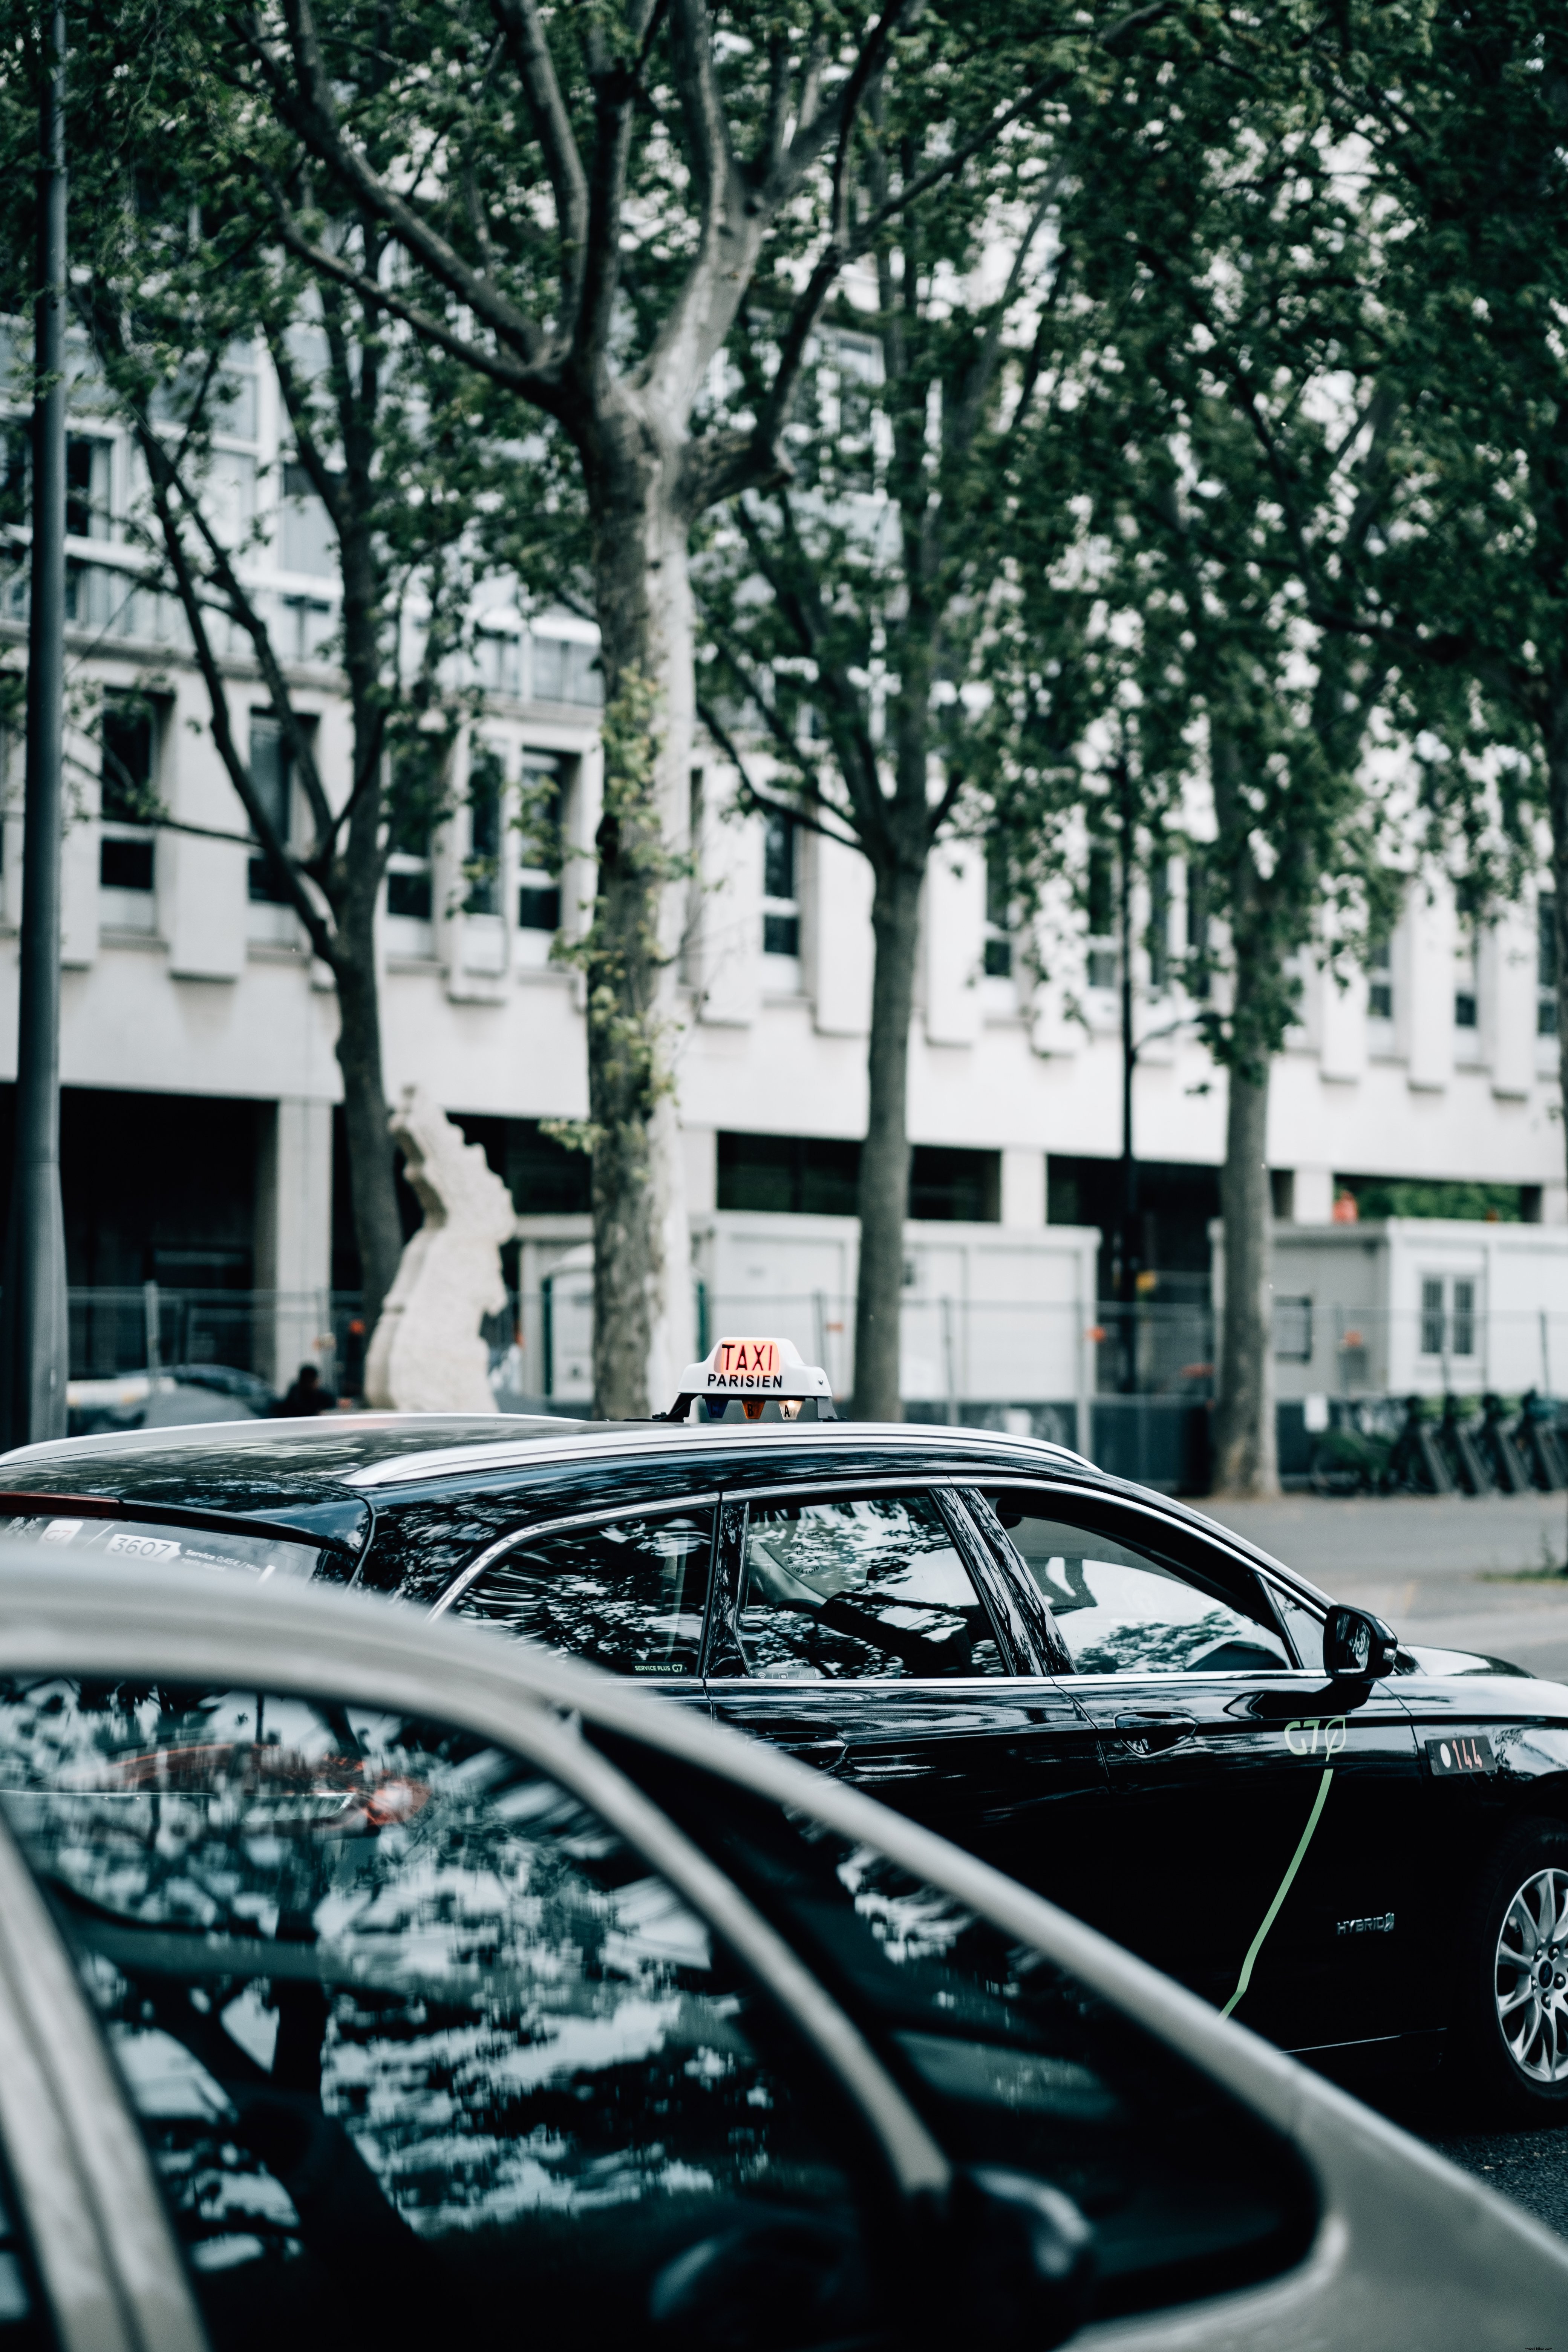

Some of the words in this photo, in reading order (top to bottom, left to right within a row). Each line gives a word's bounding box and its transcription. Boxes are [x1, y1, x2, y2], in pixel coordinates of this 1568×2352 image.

[722, 1344, 773, 1371] TAXI
[707, 1374, 782, 1388] PARISIEN
[747, 1403, 753, 1417] B
[784, 1405, 790, 1418] A
[44, 1529, 74, 1542] G7
[111, 1537, 172, 1557] 3607
[185, 1549, 216, 1560] Service
[672, 1664, 683, 1672] G7
[1284, 1720, 1320, 1755] G7
[1337, 1917, 1384, 1935] HYBRID
